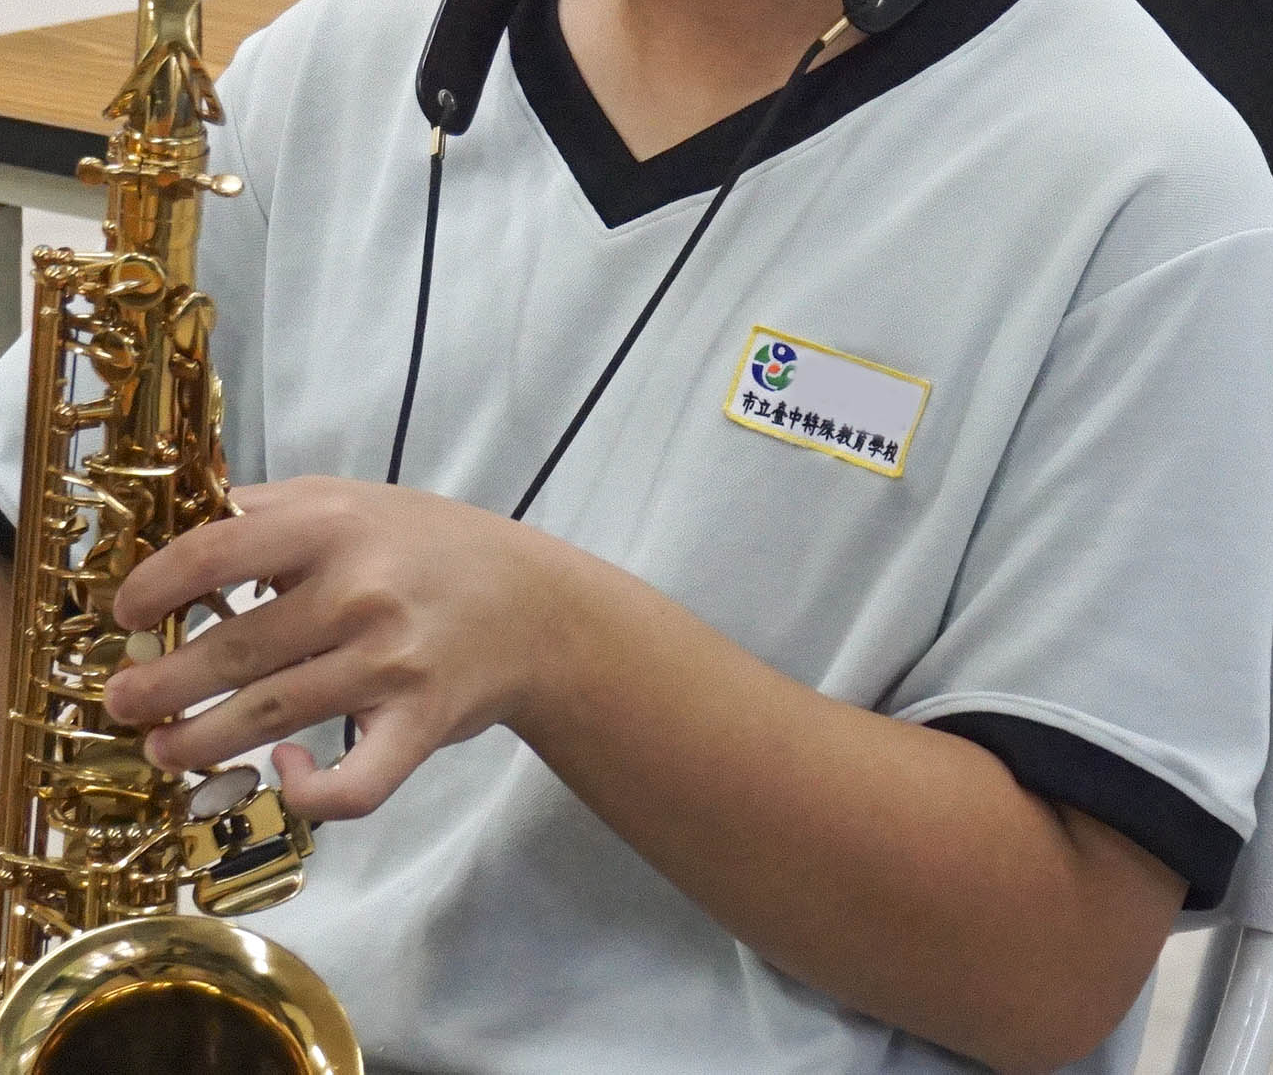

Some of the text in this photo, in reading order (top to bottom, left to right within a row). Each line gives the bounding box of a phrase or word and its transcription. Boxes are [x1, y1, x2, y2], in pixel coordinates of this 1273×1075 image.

[742, 391, 899, 463] 市立臺中特殊教育學校
